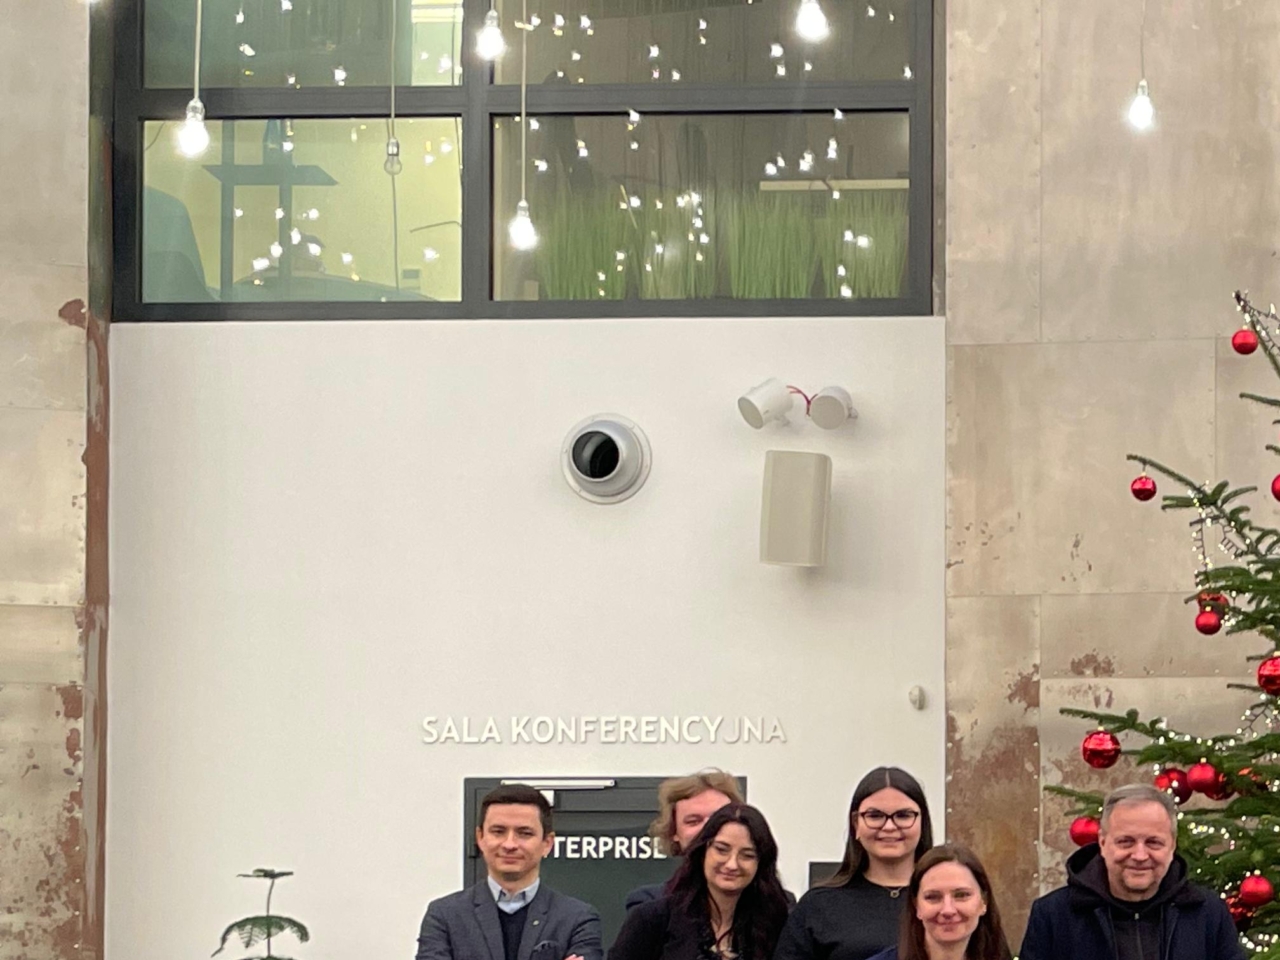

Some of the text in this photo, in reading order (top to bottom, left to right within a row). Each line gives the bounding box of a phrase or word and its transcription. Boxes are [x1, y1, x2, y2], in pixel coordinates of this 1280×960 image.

[422, 714, 788, 745] SALA KONFERENCYJNA
[545, 836, 668, 860] TERPRISE
